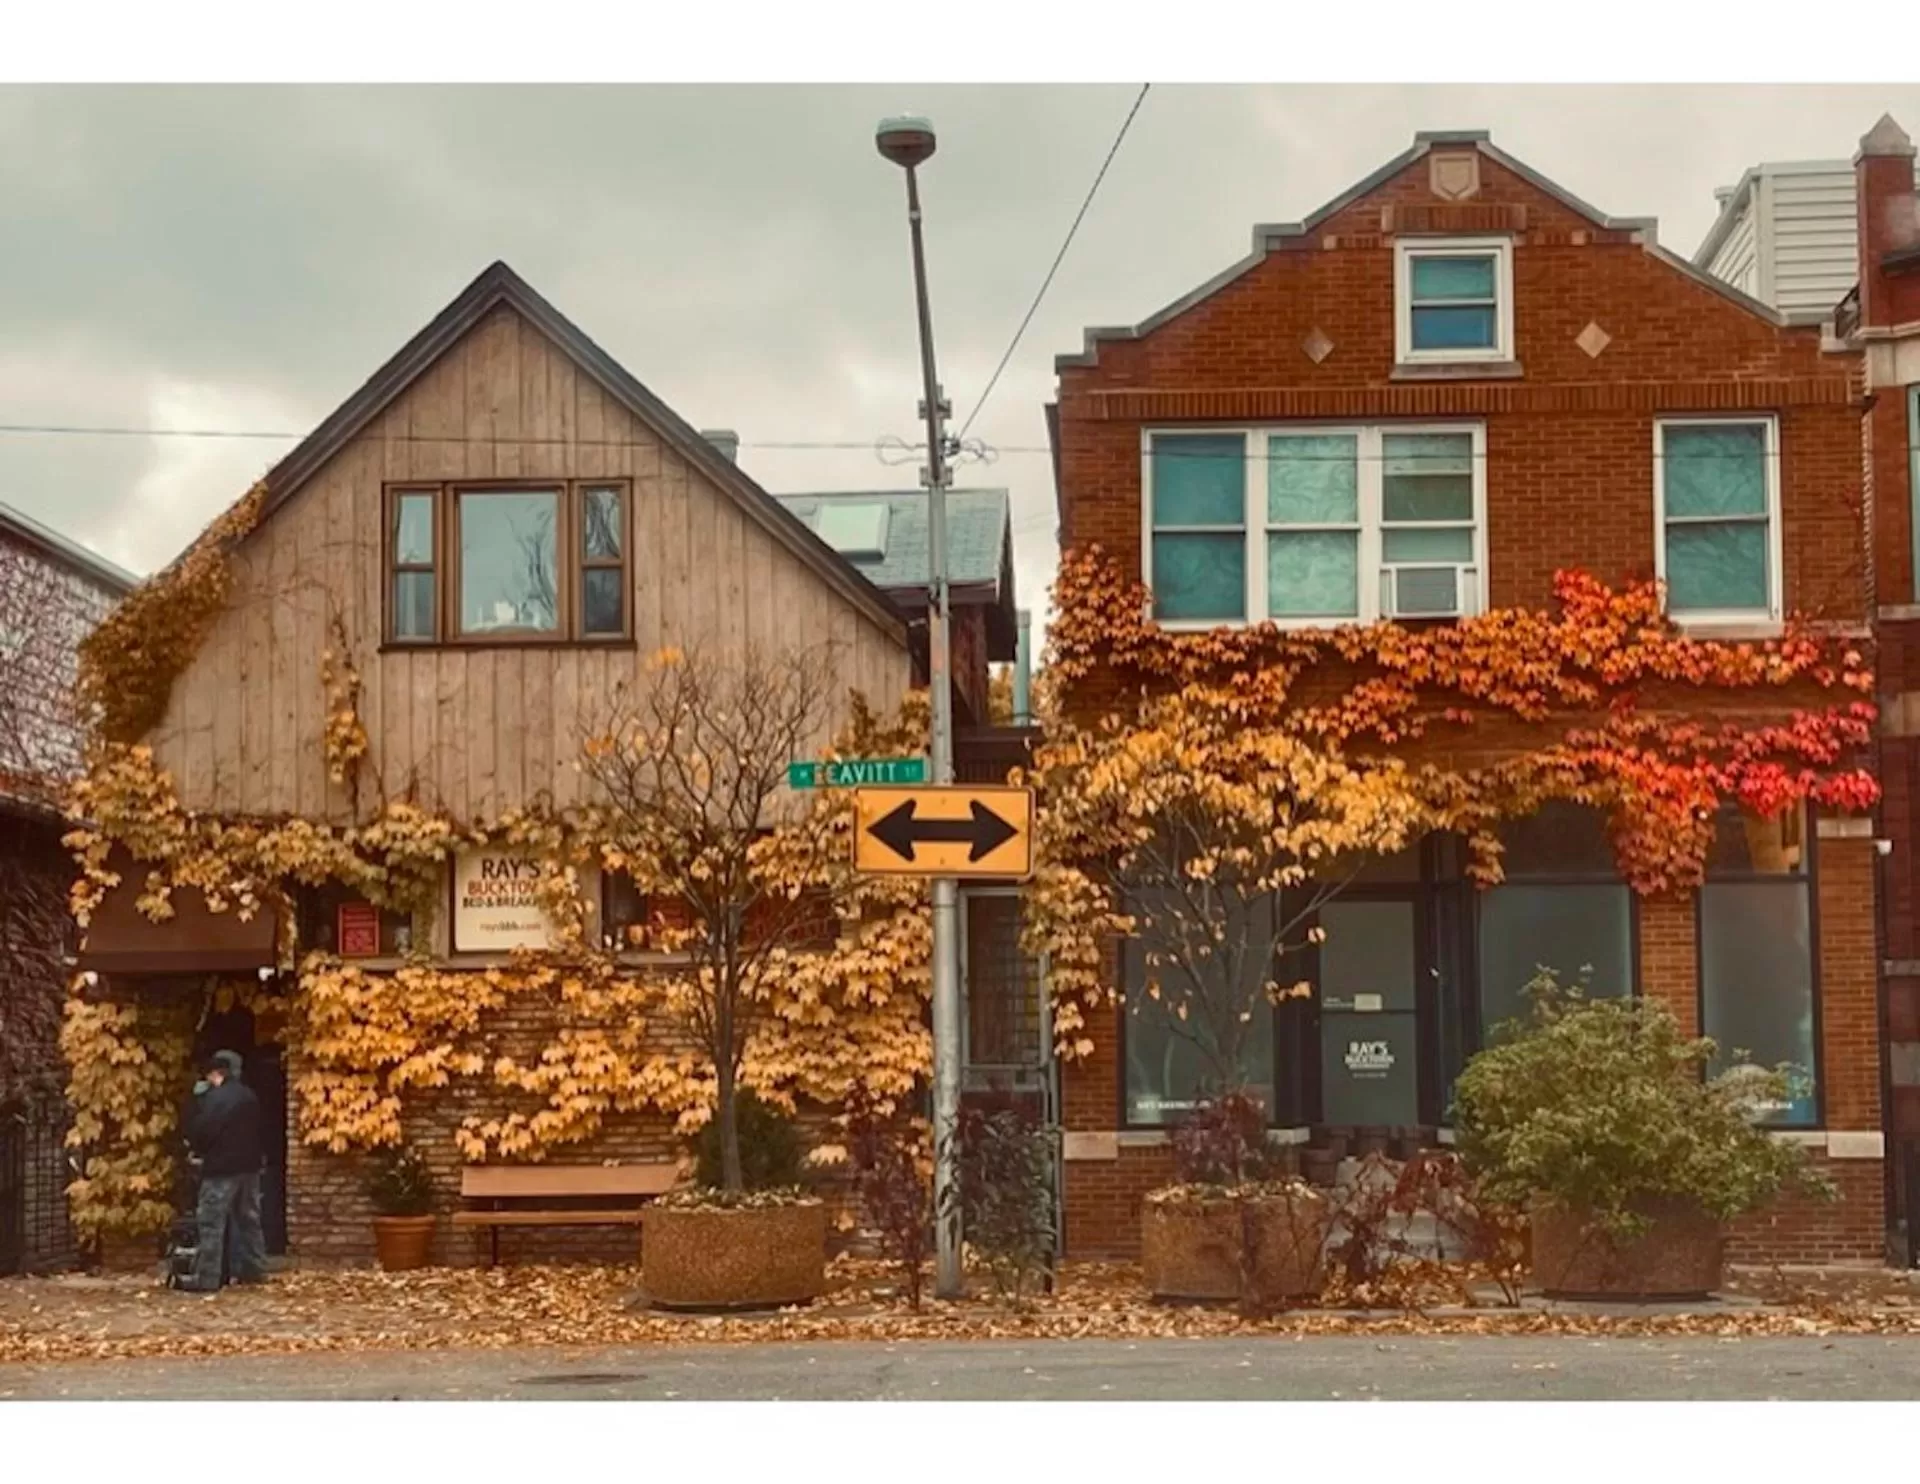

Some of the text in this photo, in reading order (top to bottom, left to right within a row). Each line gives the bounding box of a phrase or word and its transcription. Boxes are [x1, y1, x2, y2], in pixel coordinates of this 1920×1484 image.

[481, 858, 541, 879] RAY'S
[467, 880, 538, 896] BUCKTO
[497, 897, 538, 908] BREAK
